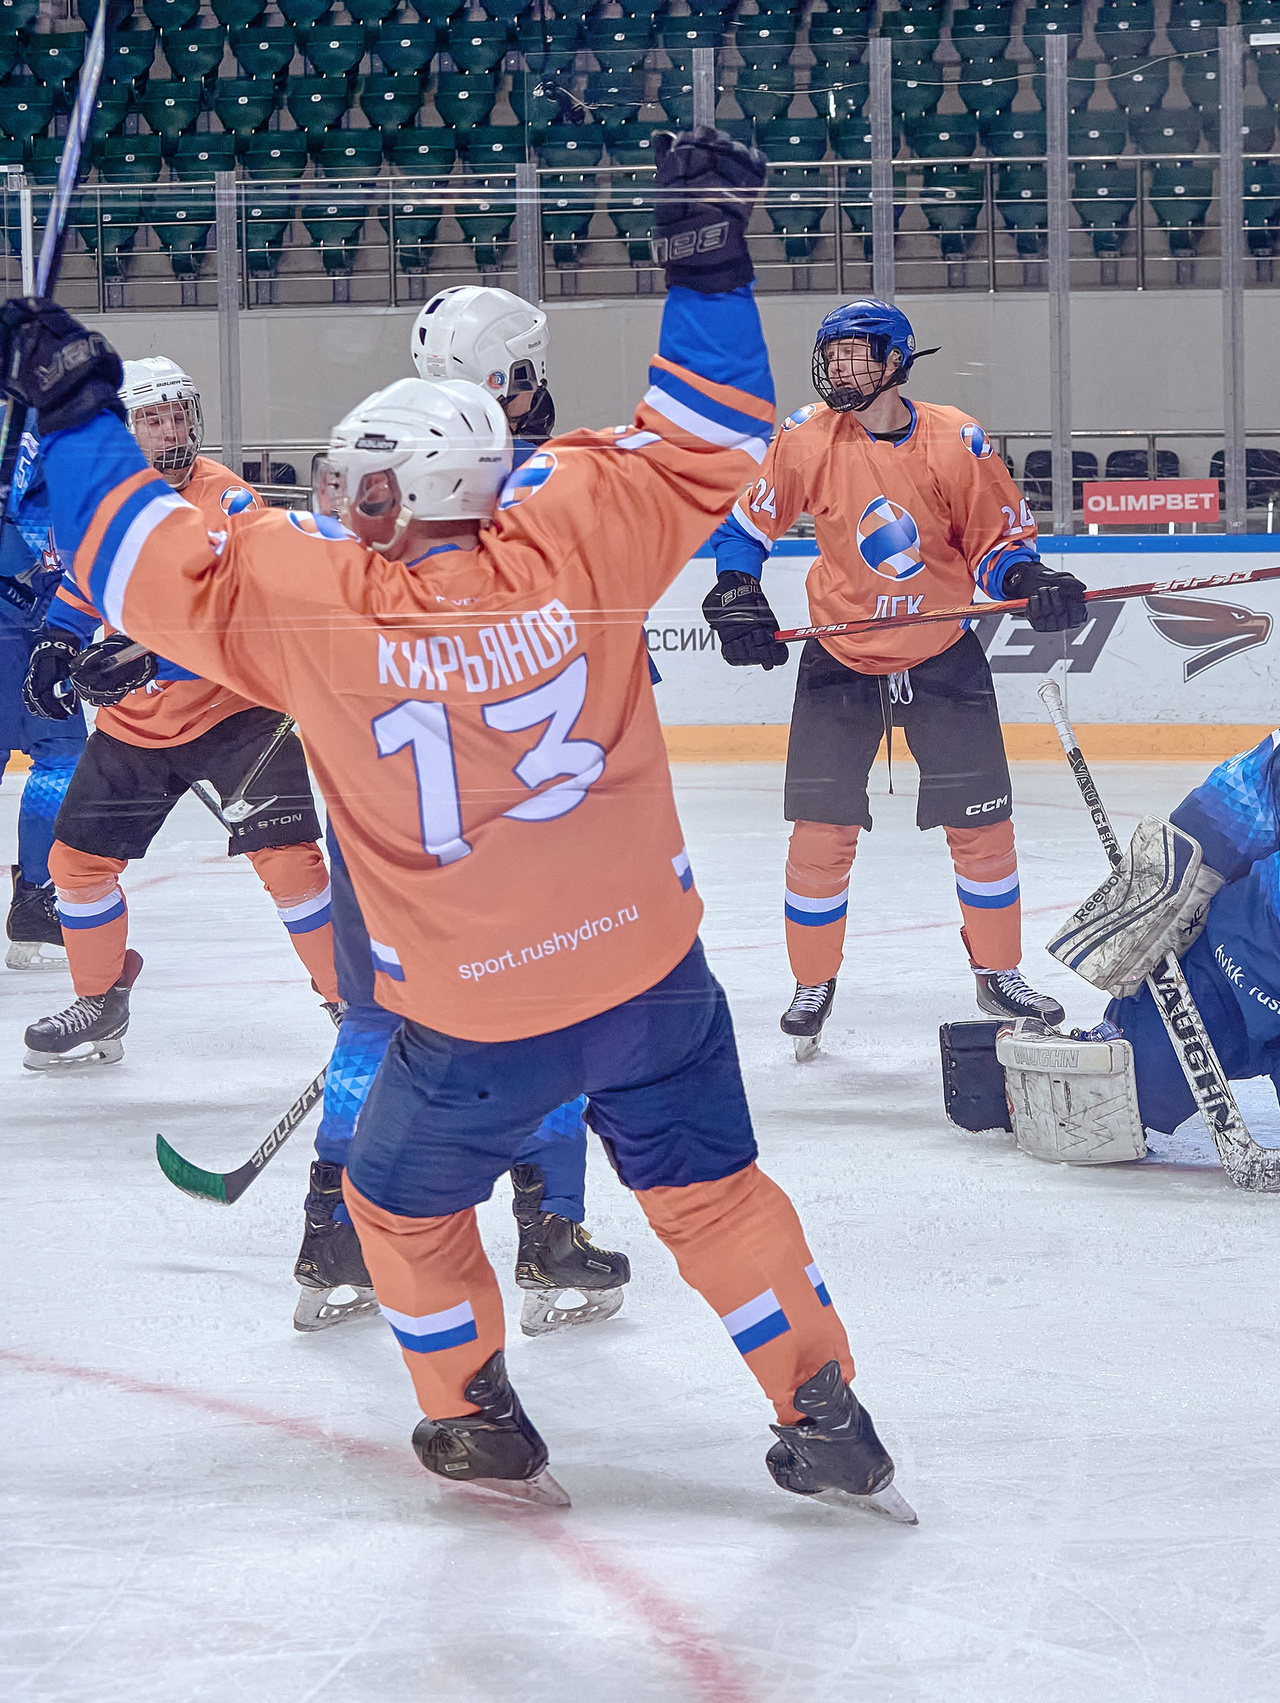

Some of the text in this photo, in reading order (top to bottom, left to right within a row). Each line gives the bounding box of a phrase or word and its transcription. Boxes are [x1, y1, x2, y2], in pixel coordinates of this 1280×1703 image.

[155, 379, 182, 388] BAUER
[751, 478, 777, 519] 24
[1001, 498, 1036, 536] 24
[1087, 492, 1214, 513] OLIMPBET
[377, 598, 578, 693] КИРЬЯНОВ
[371, 652, 606, 868] 13
[965, 794, 1009, 816] CCM
[236, 813, 303, 837] ESTON
[1073, 866, 1127, 923] Reebok
[458, 905, 639, 982] sport.rushydro.ru
[1013, 1046, 1080, 1068] VAUGHN
[1151, 956, 1236, 1134] VAUGHN
